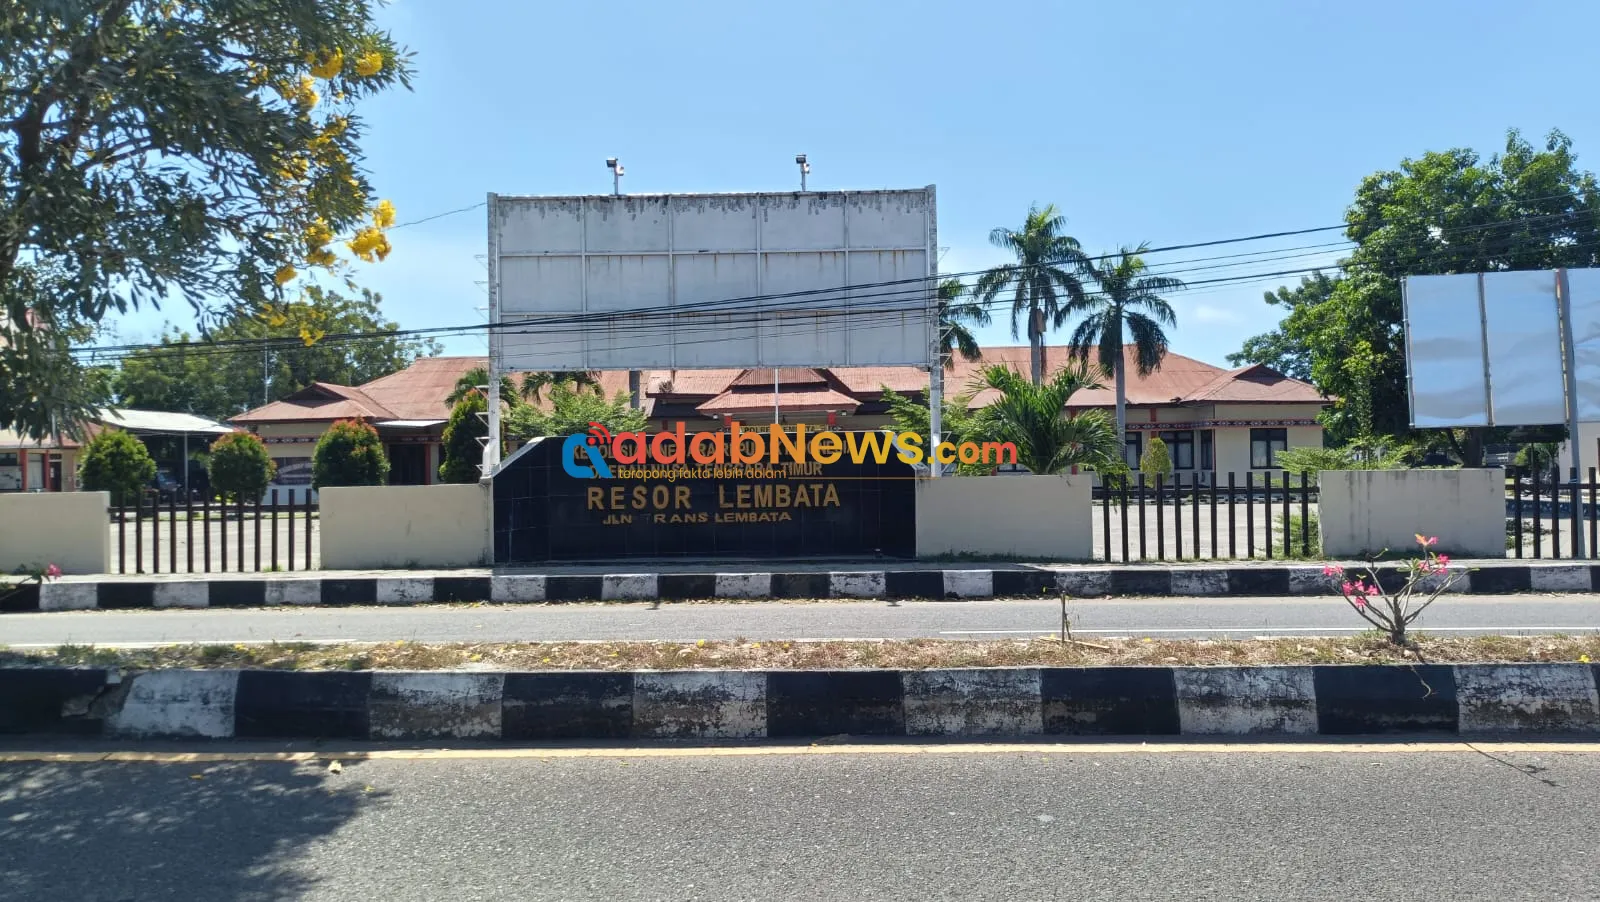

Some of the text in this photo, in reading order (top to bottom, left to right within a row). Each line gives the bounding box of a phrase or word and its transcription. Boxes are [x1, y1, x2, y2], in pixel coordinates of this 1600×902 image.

[780, 461, 823, 476] TIMUR
[587, 483, 841, 511] RESOR LEMBATA
[602, 513, 633, 525] JLN
[714, 510, 793, 523] LEMBATA
